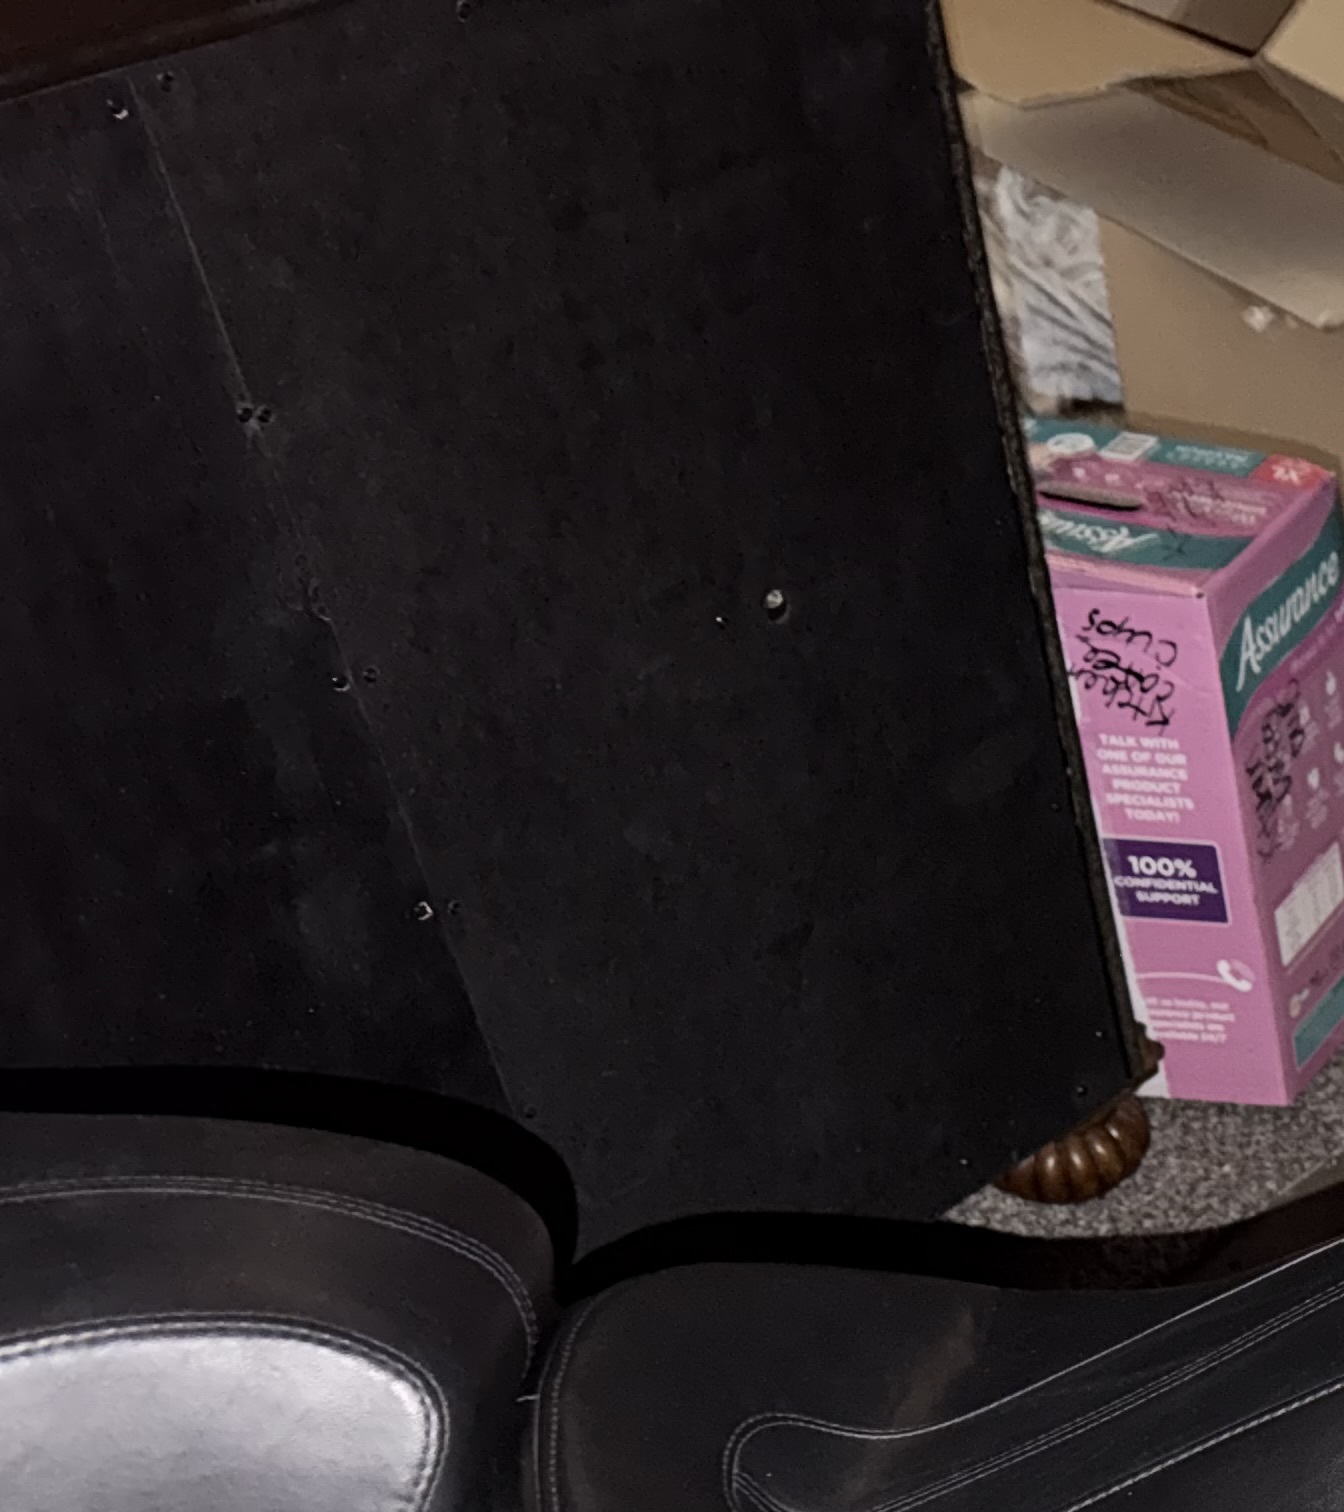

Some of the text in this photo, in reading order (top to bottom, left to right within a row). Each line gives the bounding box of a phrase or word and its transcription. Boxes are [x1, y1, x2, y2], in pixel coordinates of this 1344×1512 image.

[1234, 549, 1341, 693] Assurance
[1097, 734, 1180, 750] TALK WITH
[1096, 749, 1188, 766] ONE OF OUR
[1102, 764, 1189, 781] ASSURANCE
[1112, 778, 1183, 794] PRODUCT
[1105, 792, 1195, 811] SPECIALISTS
[1124, 807, 1181, 824] TODAY!
[1127, 854, 1198, 879] 100%
[1114, 875, 1220, 895] CONFIDENTIAL
[1135, 890, 1202, 907] SUPPORT
